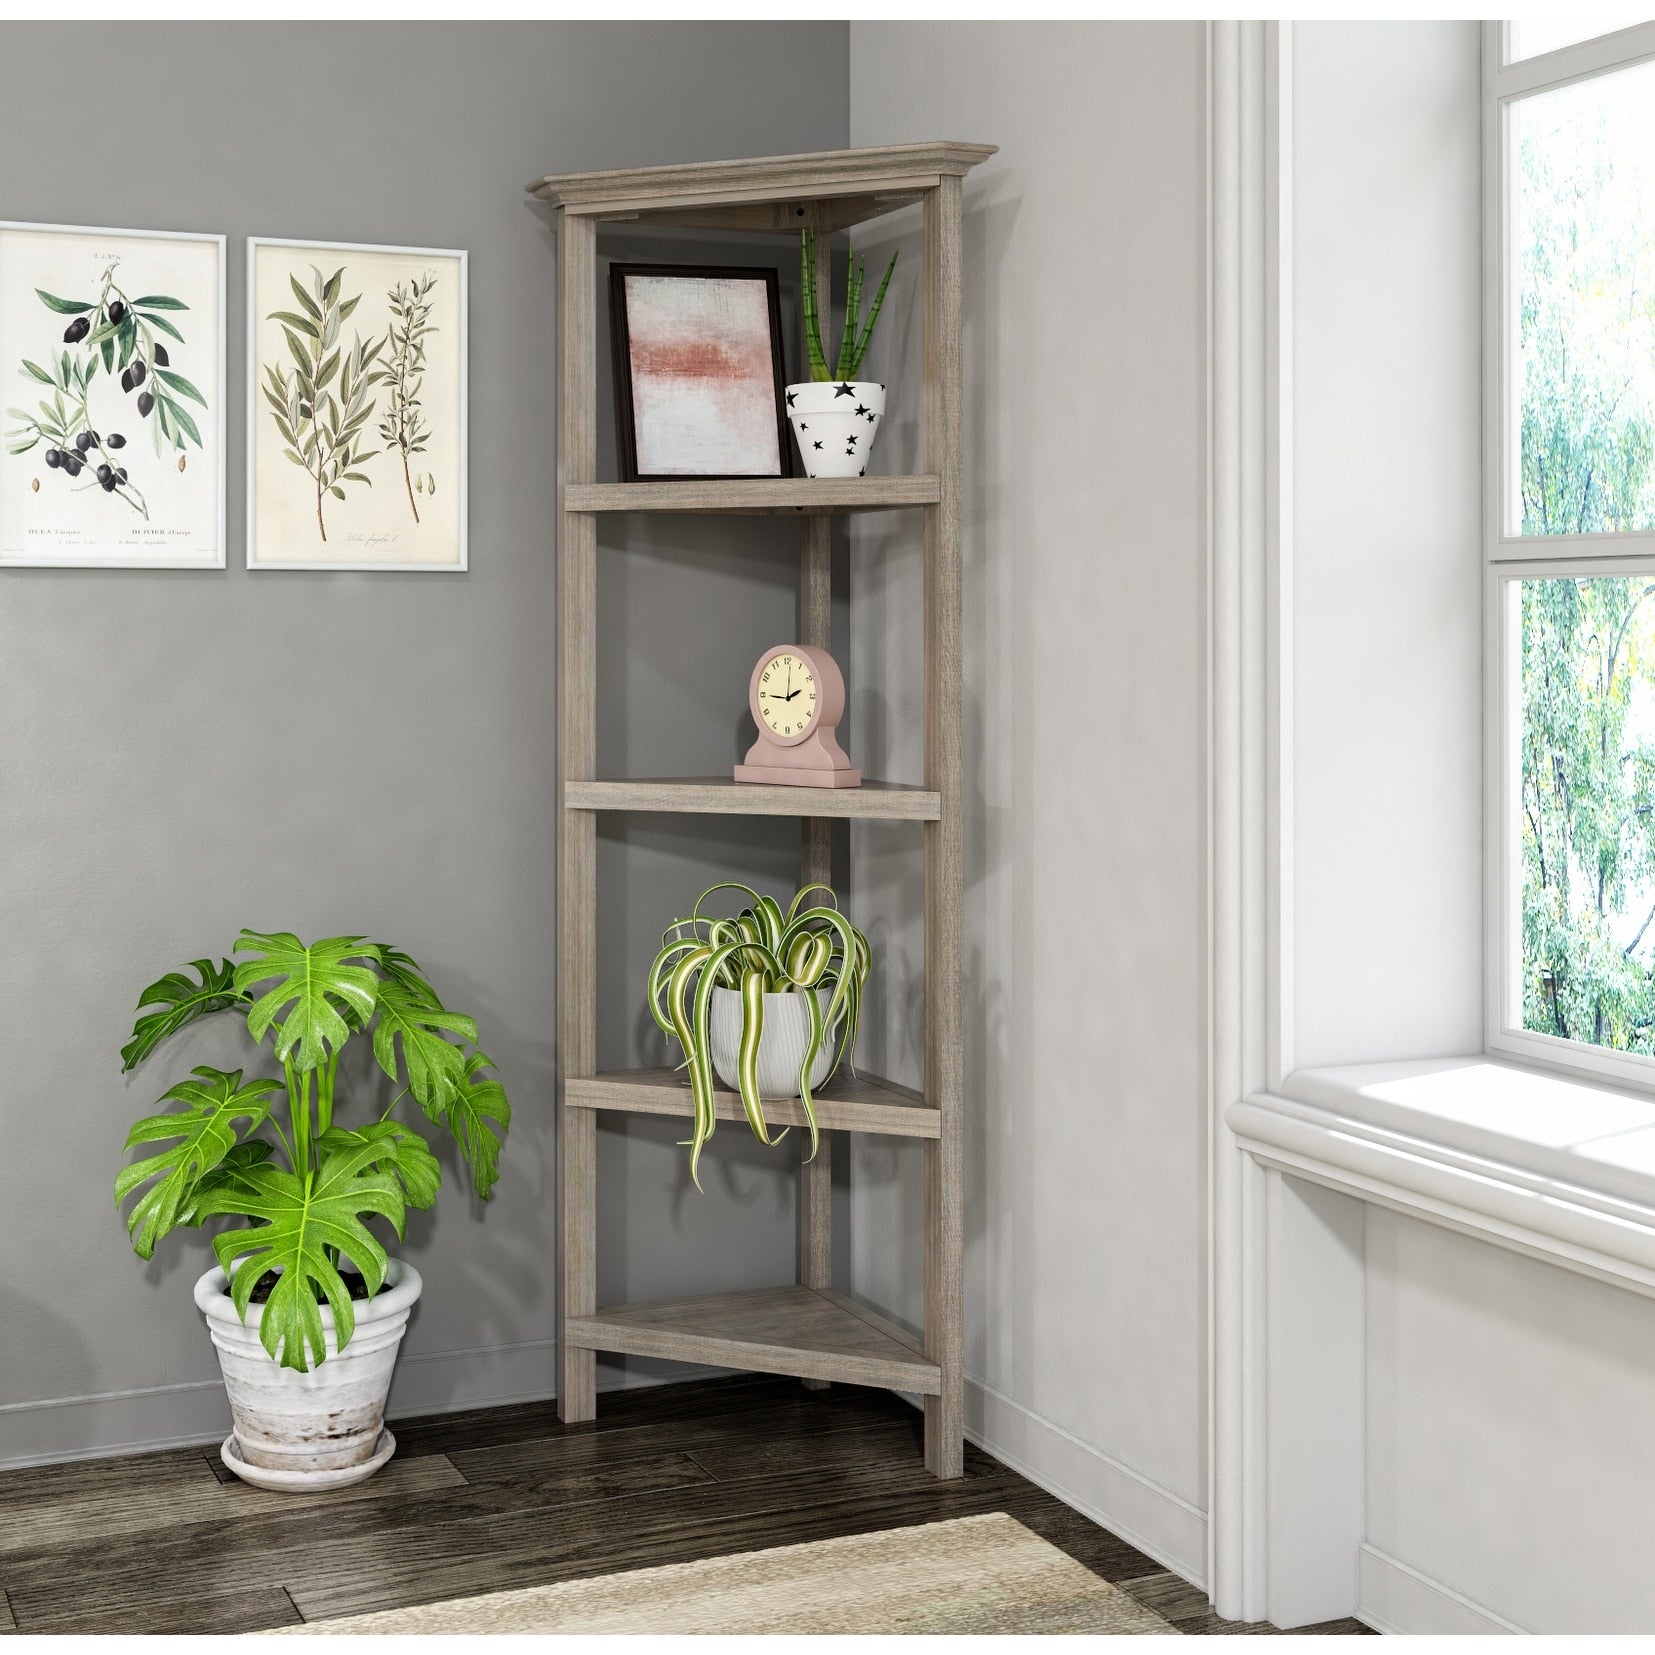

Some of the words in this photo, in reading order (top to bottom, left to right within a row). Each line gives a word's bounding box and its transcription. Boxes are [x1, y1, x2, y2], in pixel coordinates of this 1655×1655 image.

[772, 660, 780, 670] 11
[784, 657, 792, 665] 12
[762, 672, 770, 682] 10
